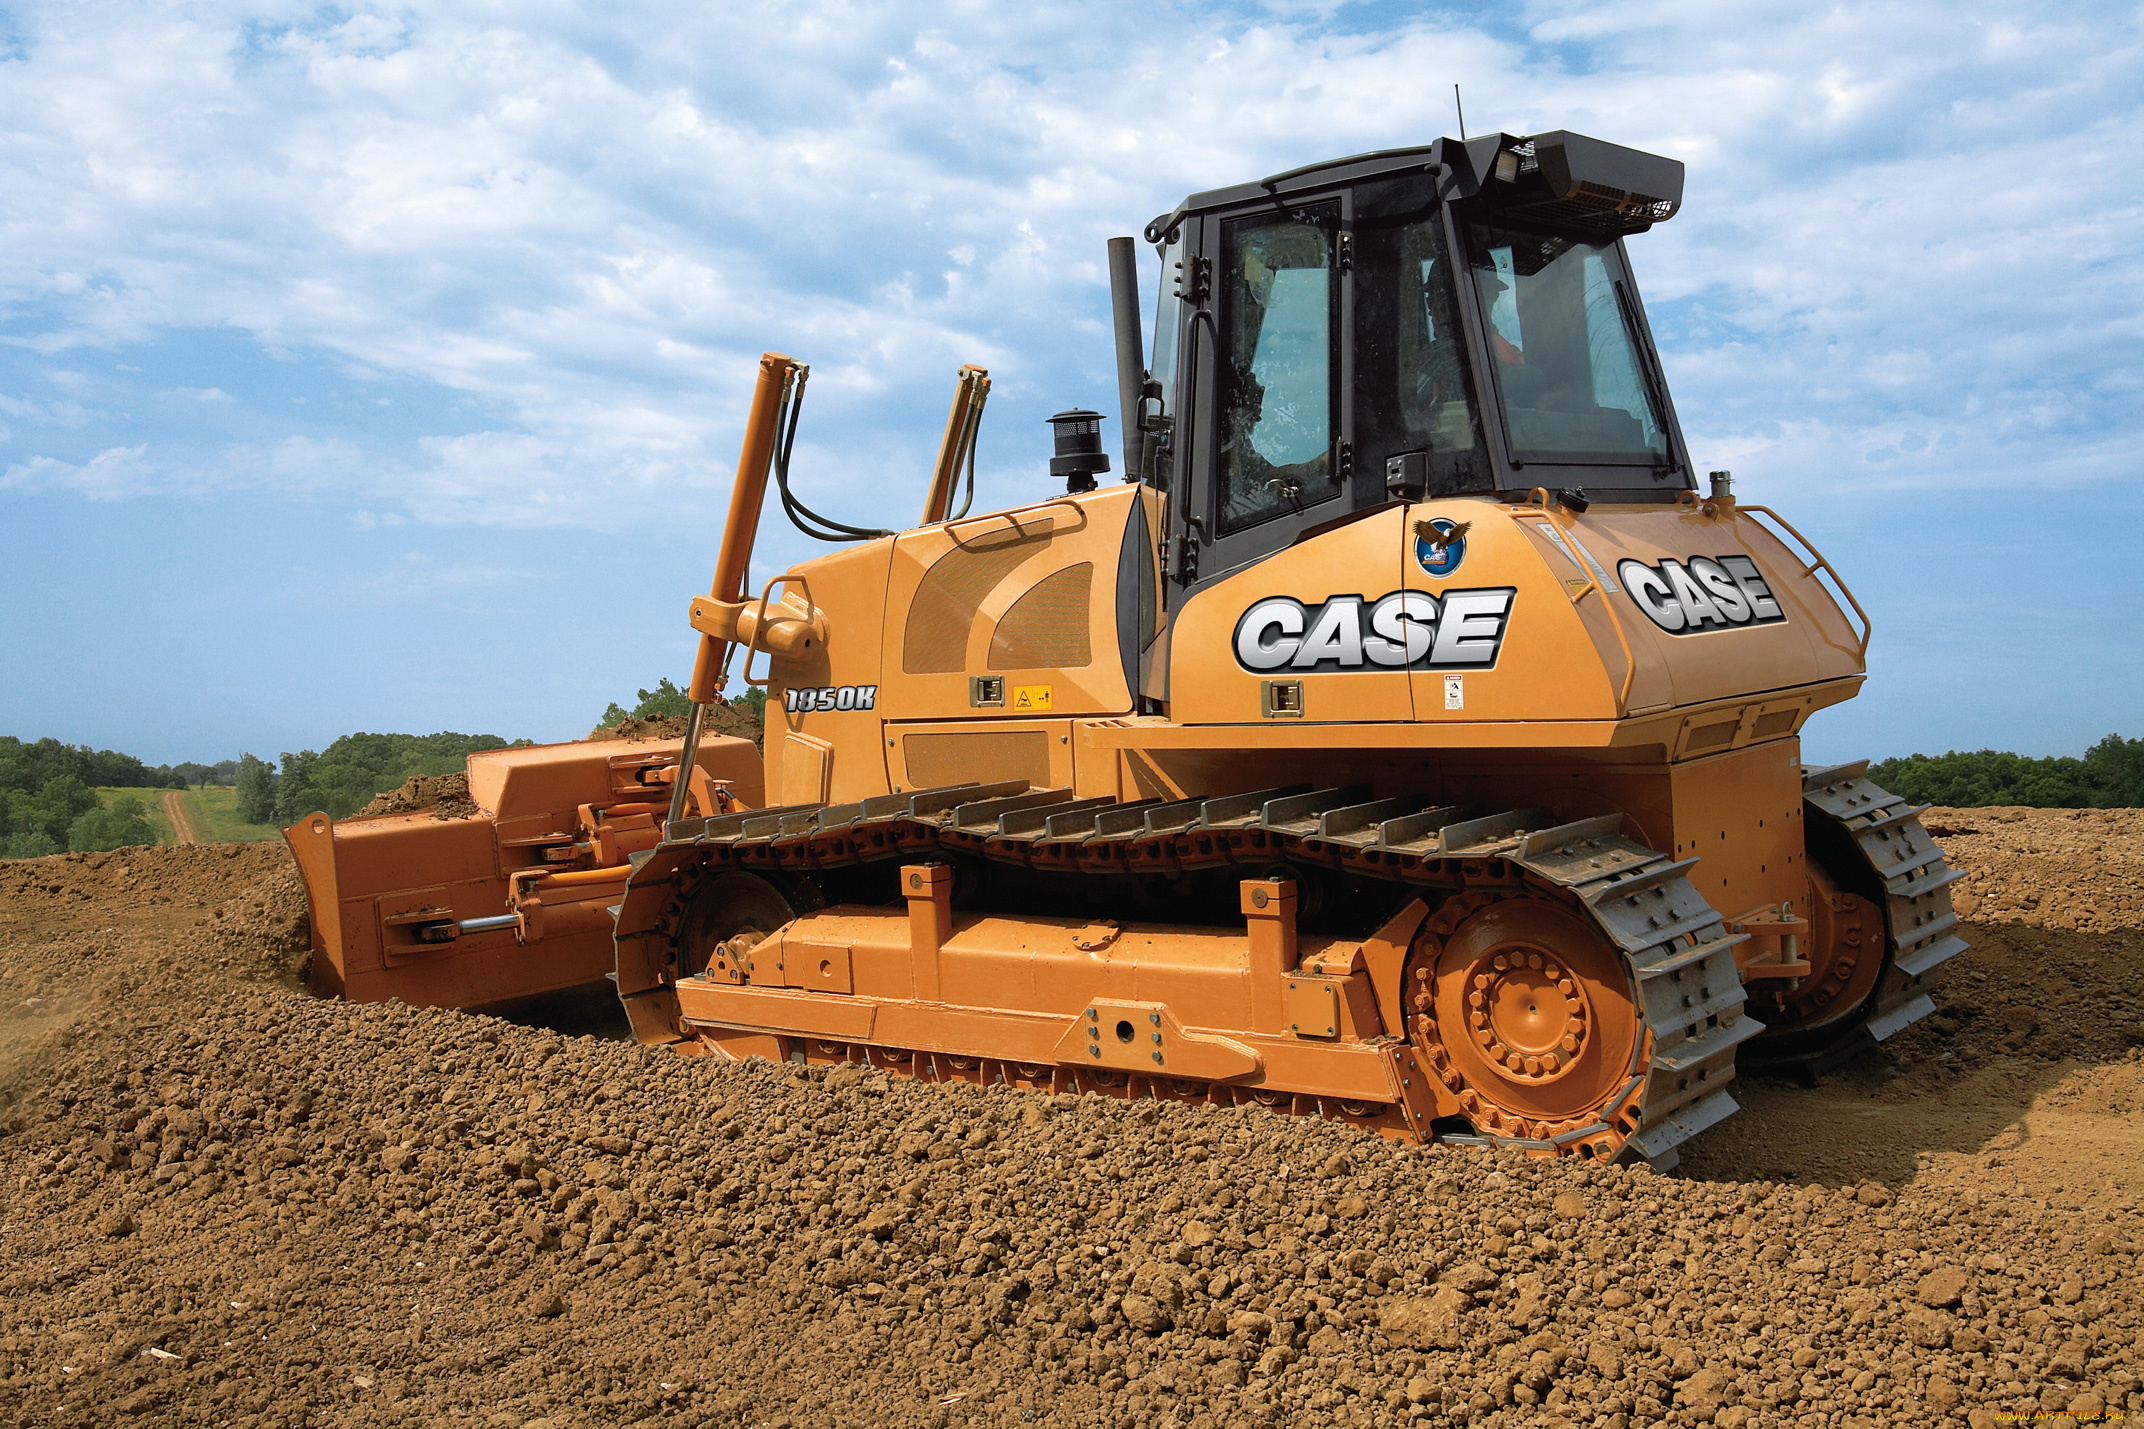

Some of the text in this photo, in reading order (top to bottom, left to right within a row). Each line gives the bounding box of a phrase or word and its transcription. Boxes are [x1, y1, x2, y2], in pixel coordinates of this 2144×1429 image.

[1235, 590, 1514, 671] CASE
[1620, 556, 1784, 631] CASE
[786, 685, 878, 712] 1850K
